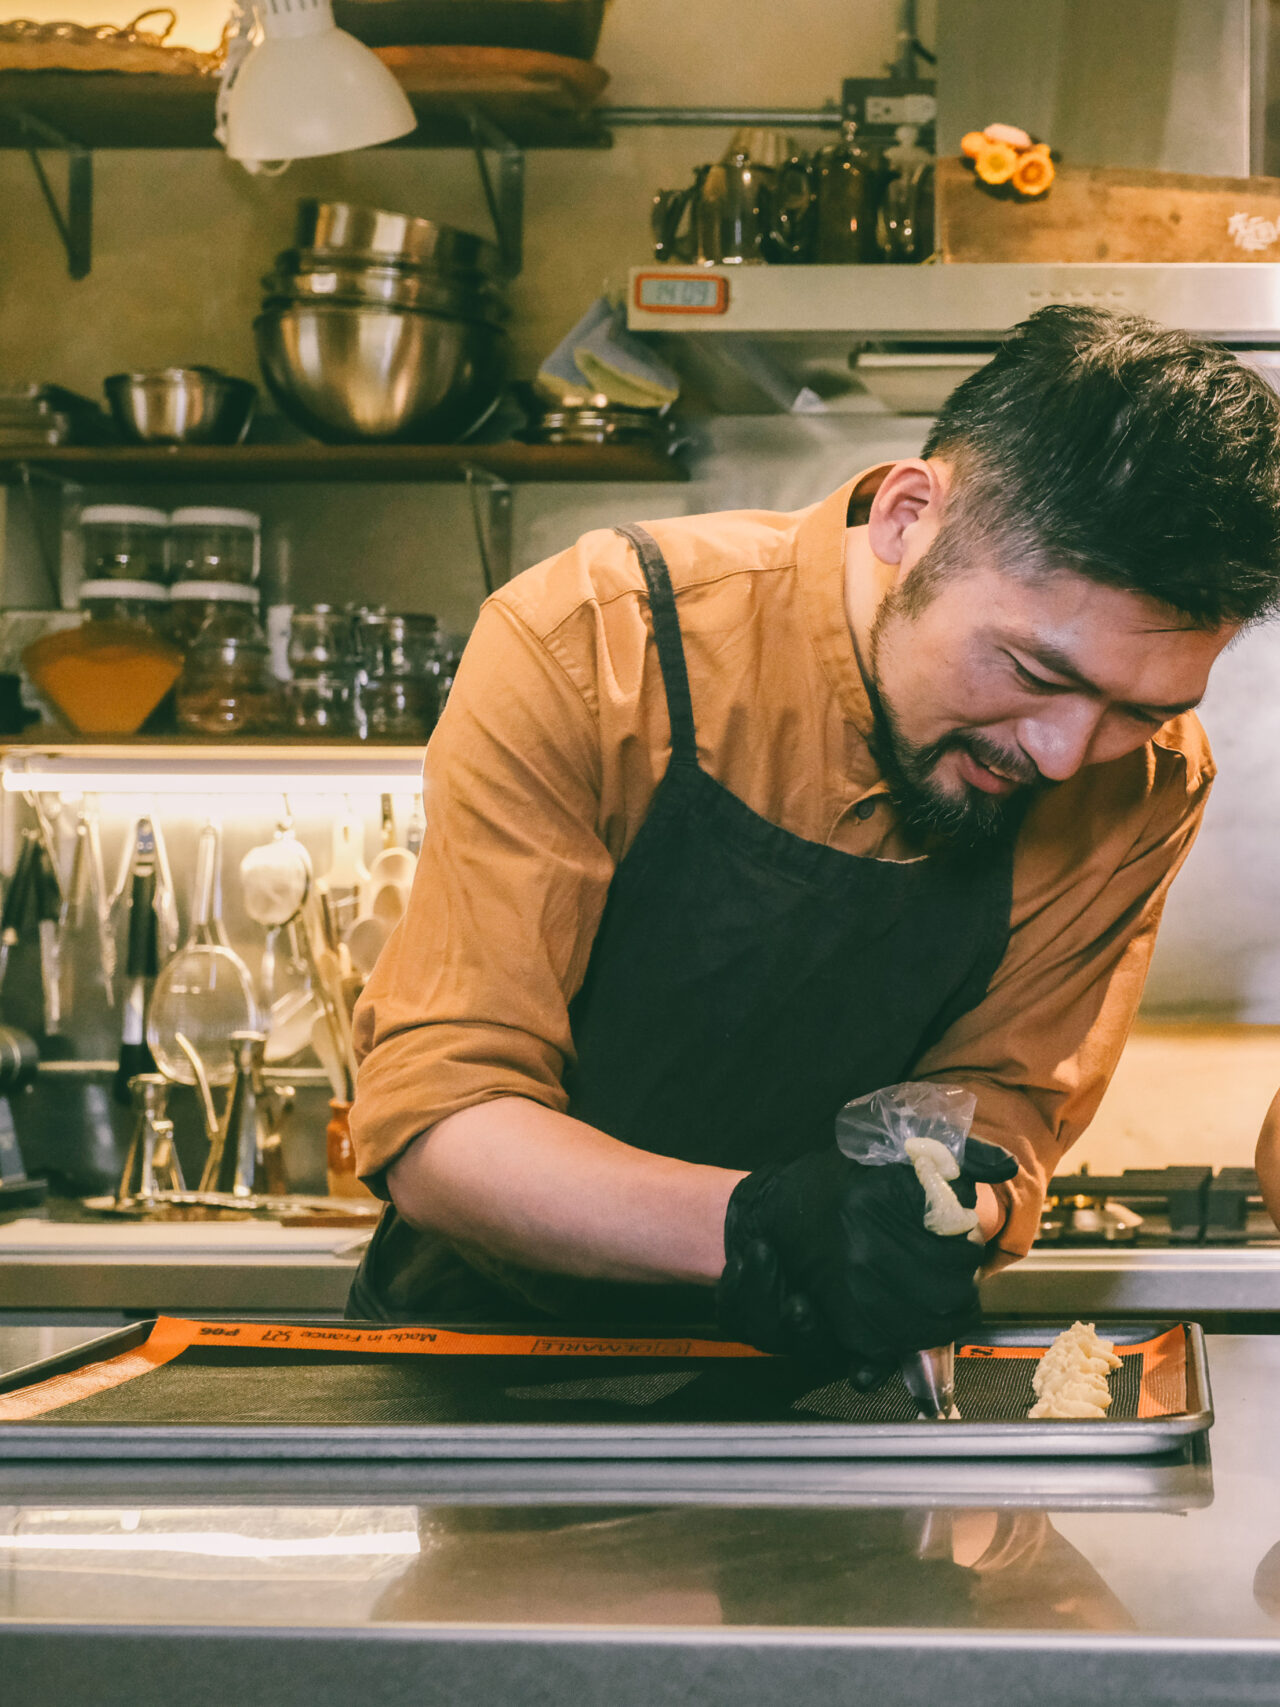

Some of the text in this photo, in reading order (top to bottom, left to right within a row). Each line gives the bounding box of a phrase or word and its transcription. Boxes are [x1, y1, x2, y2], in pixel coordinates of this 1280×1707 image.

[300, 1331, 362, 1342] France
[367, 1334, 383, 1342] in
[388, 1333, 437, 1342] Made
